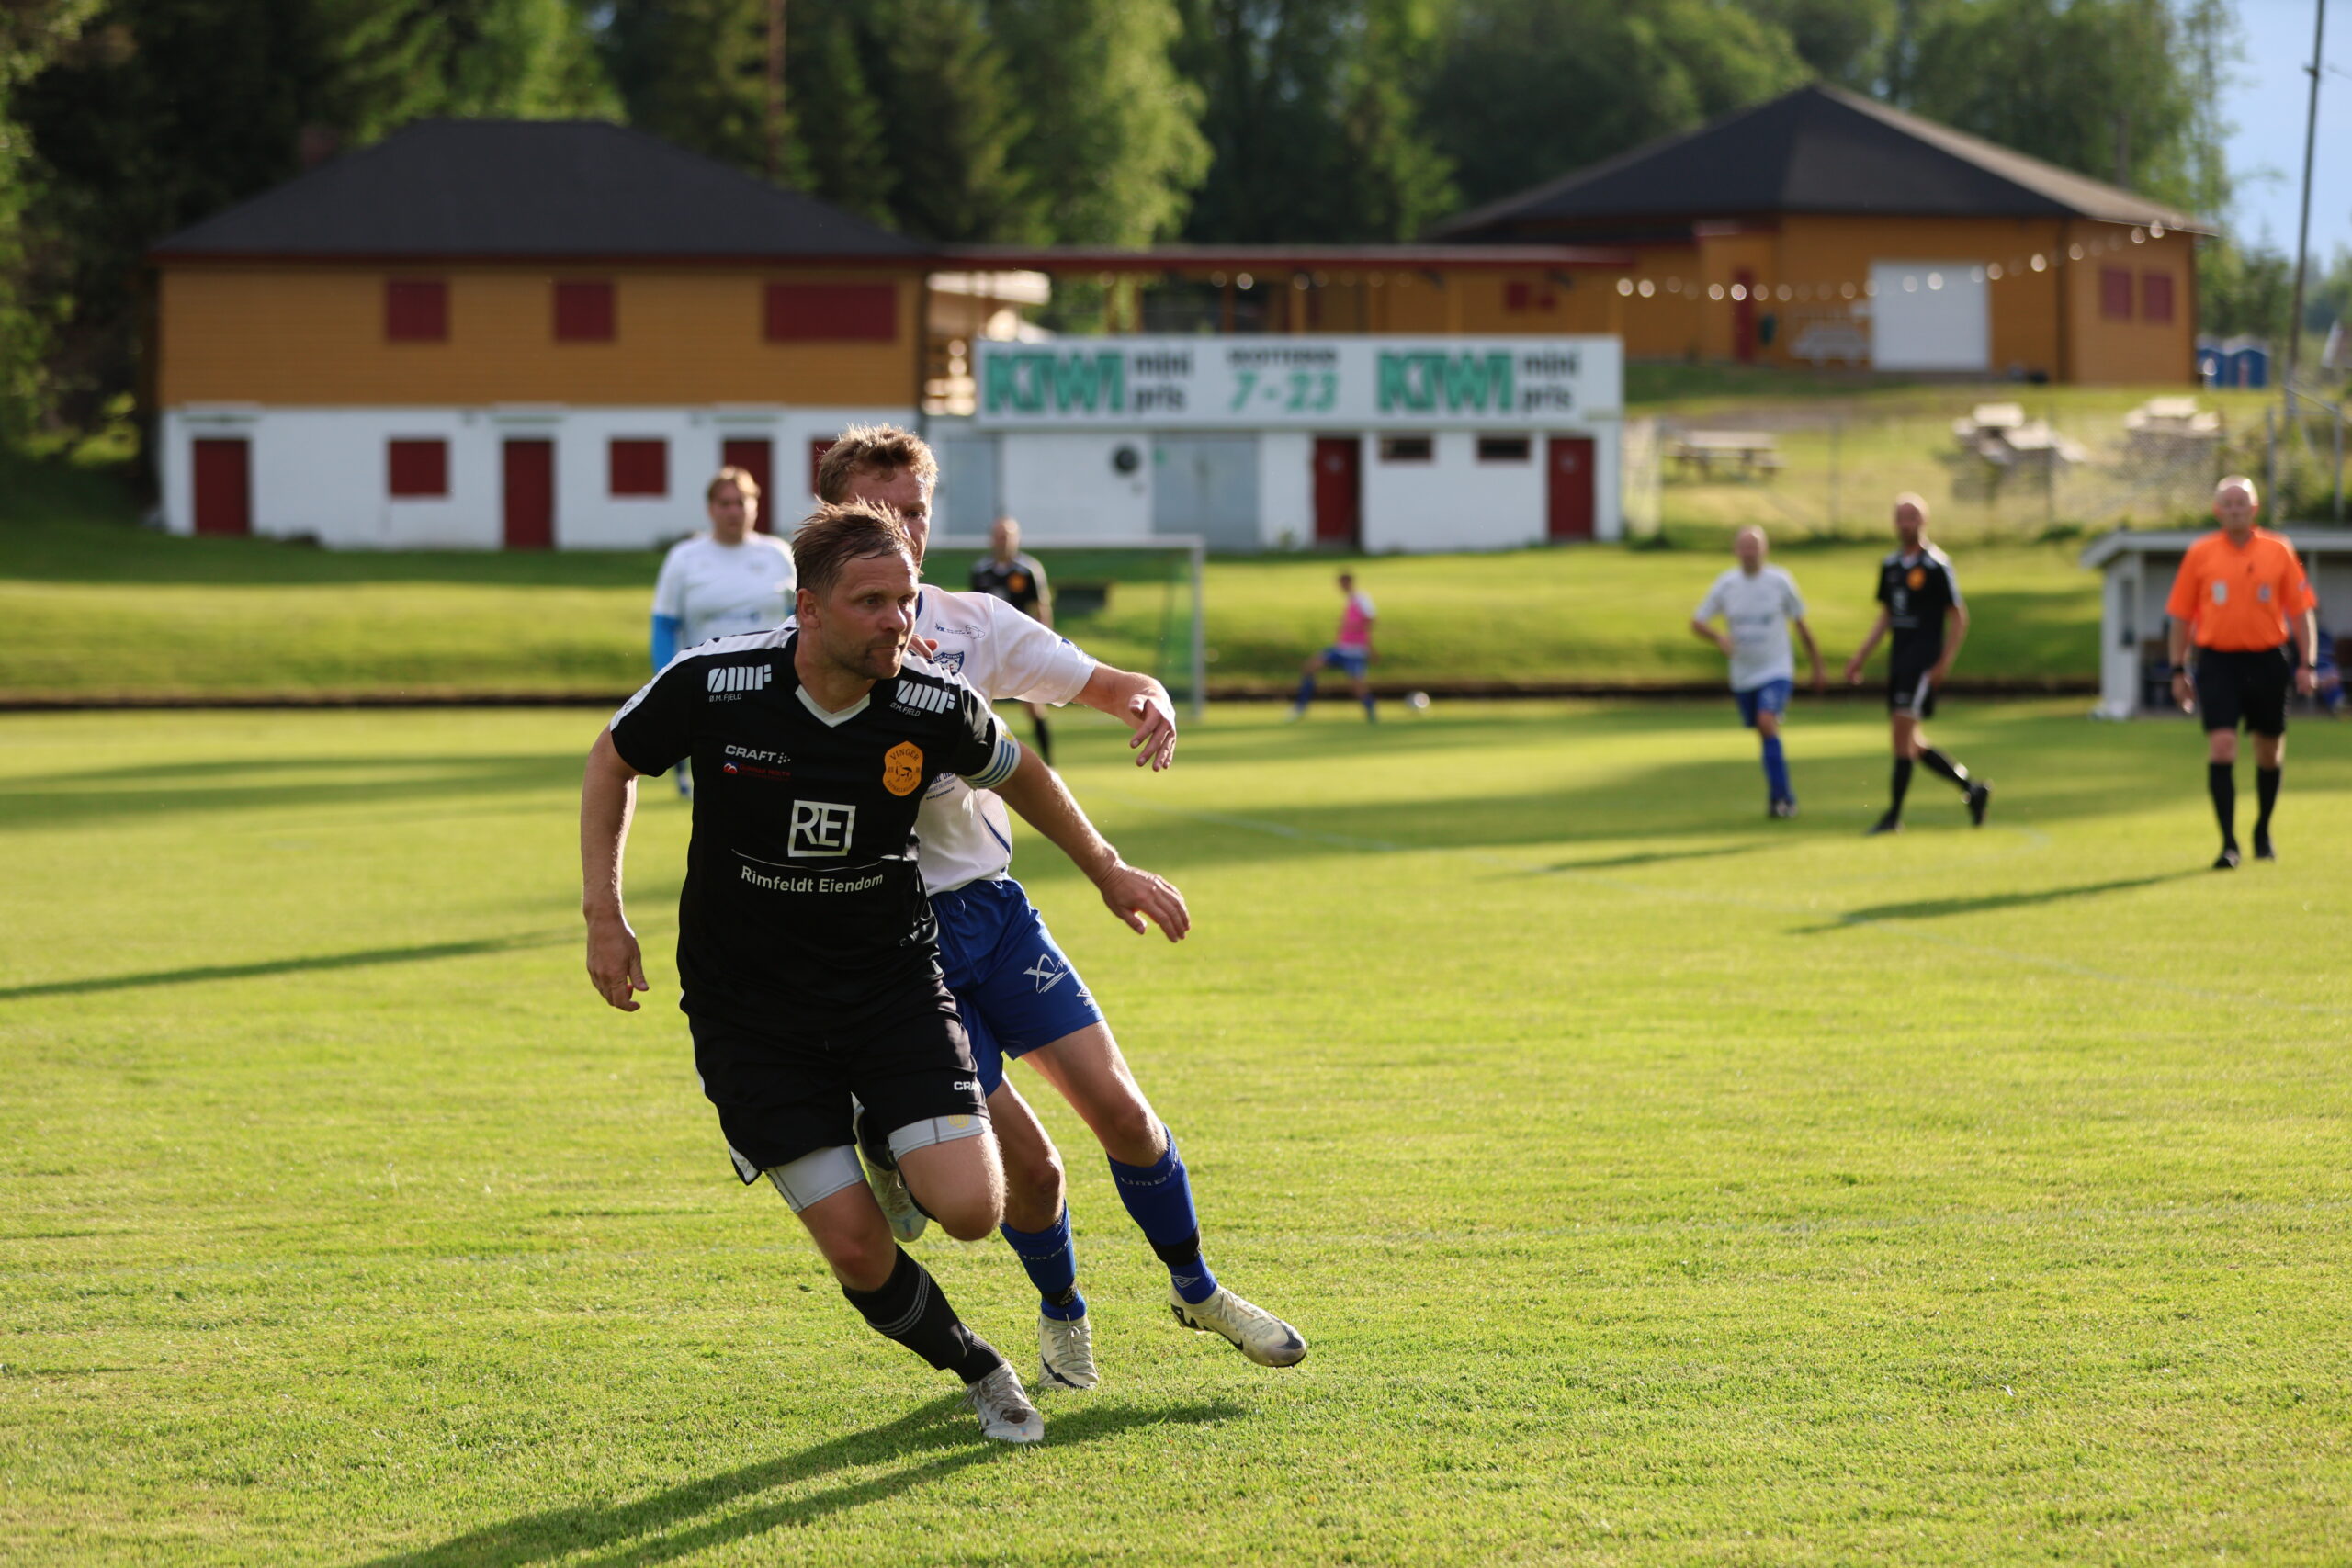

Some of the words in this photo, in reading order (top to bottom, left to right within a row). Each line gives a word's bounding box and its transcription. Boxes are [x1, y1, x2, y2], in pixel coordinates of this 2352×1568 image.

[1136, 350, 1190, 375] mini
[1523, 350, 1577, 375] mini
[985, 352, 1124, 412] KIWI
[1378, 352, 1513, 412] KIWI
[1136, 383, 1185, 413] pris
[1523, 383, 1573, 413] pris
[723, 693, 742, 702] FJELD
[902, 706, 921, 716] FJELD
[725, 744, 777, 761] CRAFT
[890, 748, 920, 761] VINGER
[741, 865, 814, 892] Rimfeldt
[819, 874, 884, 893] Eiendom
[954, 1080, 978, 1091] CRA
